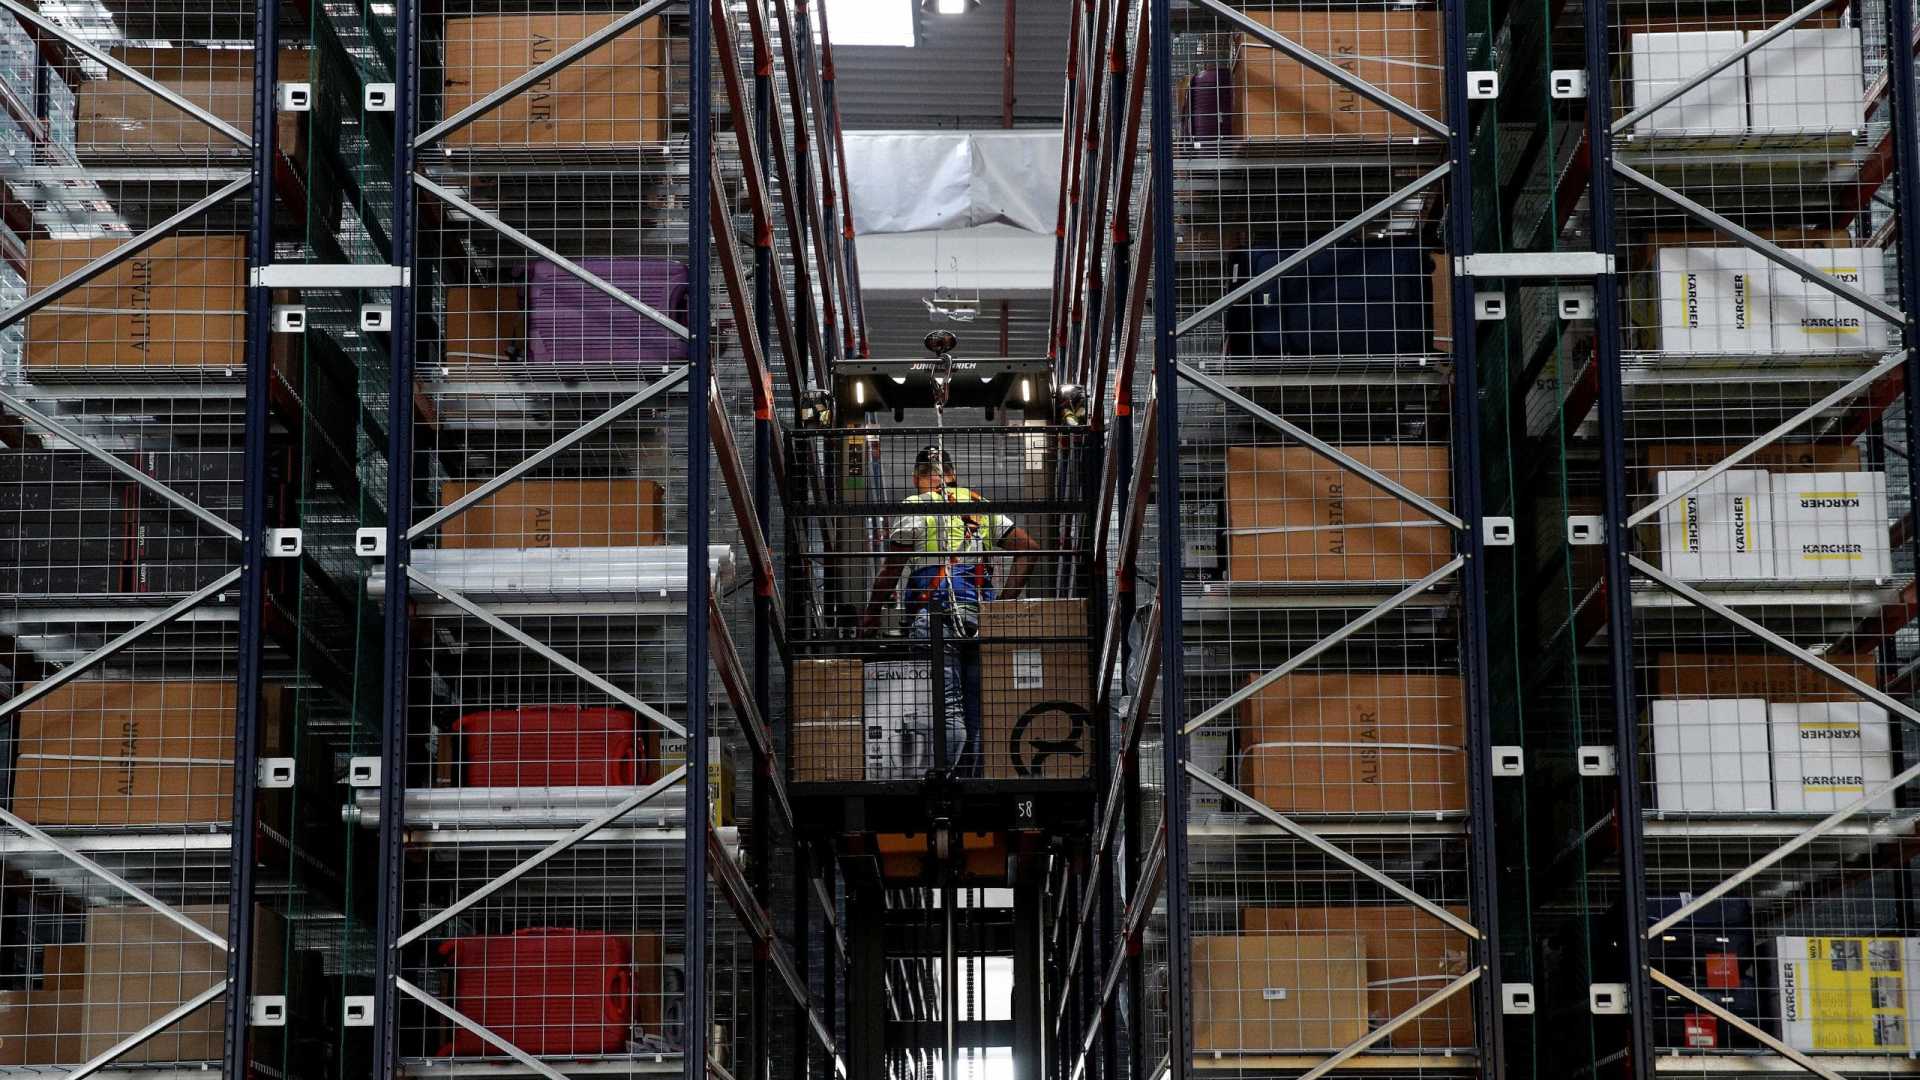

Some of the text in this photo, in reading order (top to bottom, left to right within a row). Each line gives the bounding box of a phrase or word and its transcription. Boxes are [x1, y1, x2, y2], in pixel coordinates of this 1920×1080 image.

[532, 33, 552, 123] ALITAIR
[1338, 46, 1354, 114] ALIAR
[910, 362, 977, 371] JUNGRICH
[1018, 800, 1032, 818] 58
